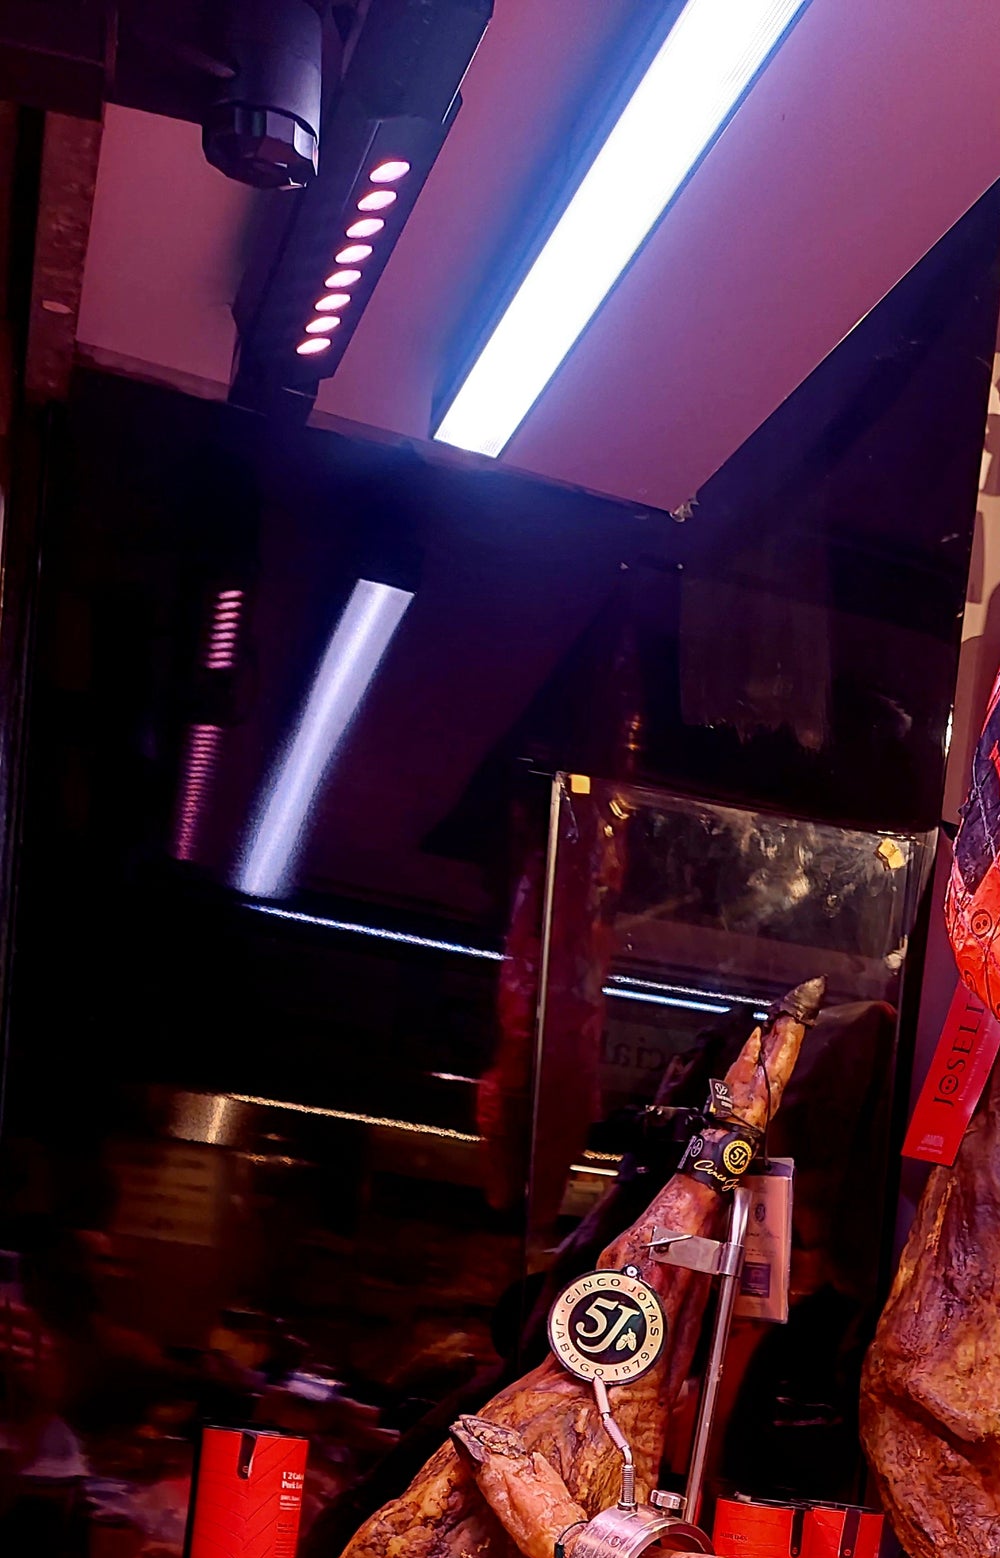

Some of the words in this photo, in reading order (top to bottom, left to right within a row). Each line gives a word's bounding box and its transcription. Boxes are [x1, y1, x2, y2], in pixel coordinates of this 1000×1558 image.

[933, 995, 985, 1107] JOSELI
[565, 1277, 620, 1305] CINCO
[628, 1284, 660, 1336] JOTAS
[555, 1318, 605, 1377] JABUGO
[613, 1351, 651, 1377] 1879
[575, 1296, 641, 1354] 5J
